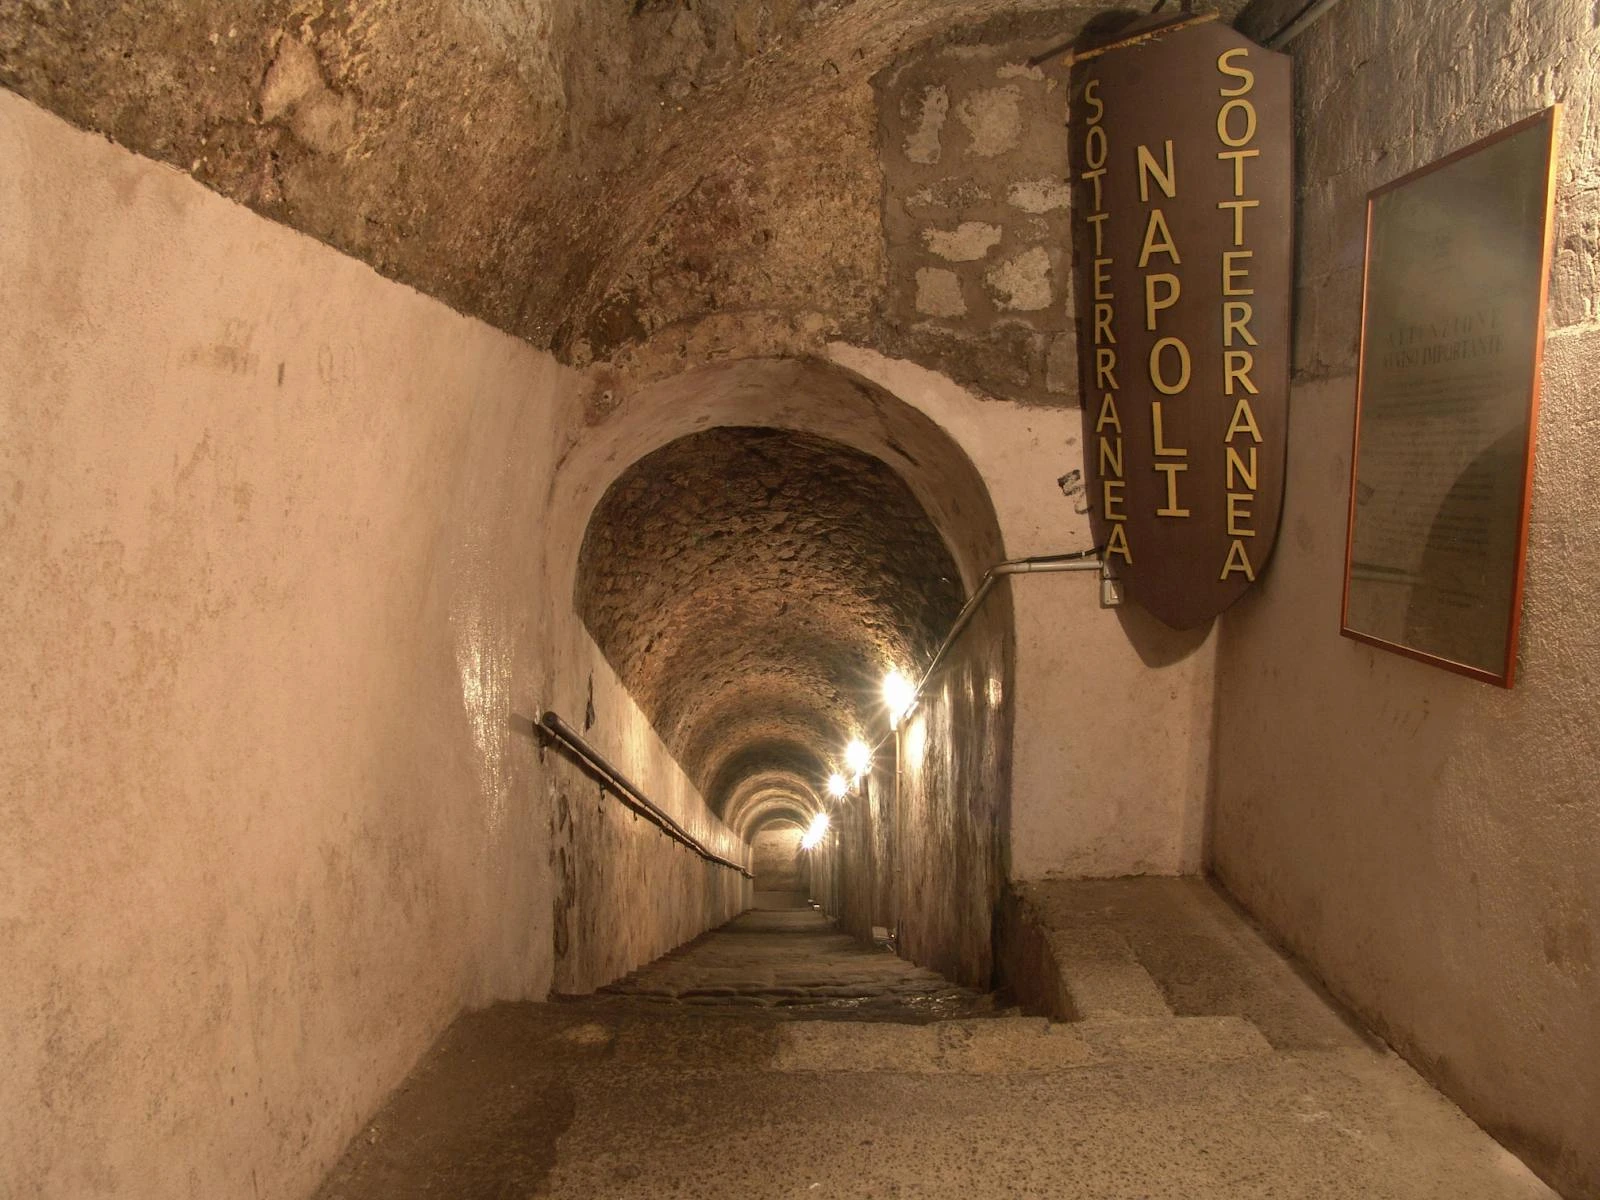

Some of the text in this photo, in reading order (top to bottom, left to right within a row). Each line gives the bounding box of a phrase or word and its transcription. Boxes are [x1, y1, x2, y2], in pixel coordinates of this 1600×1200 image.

[1082, 79, 1132, 565] SOTTERRANEA
[1137, 139, 1191, 518] NAPOLI
[1216, 47, 1264, 582] SOTTERRANEA
